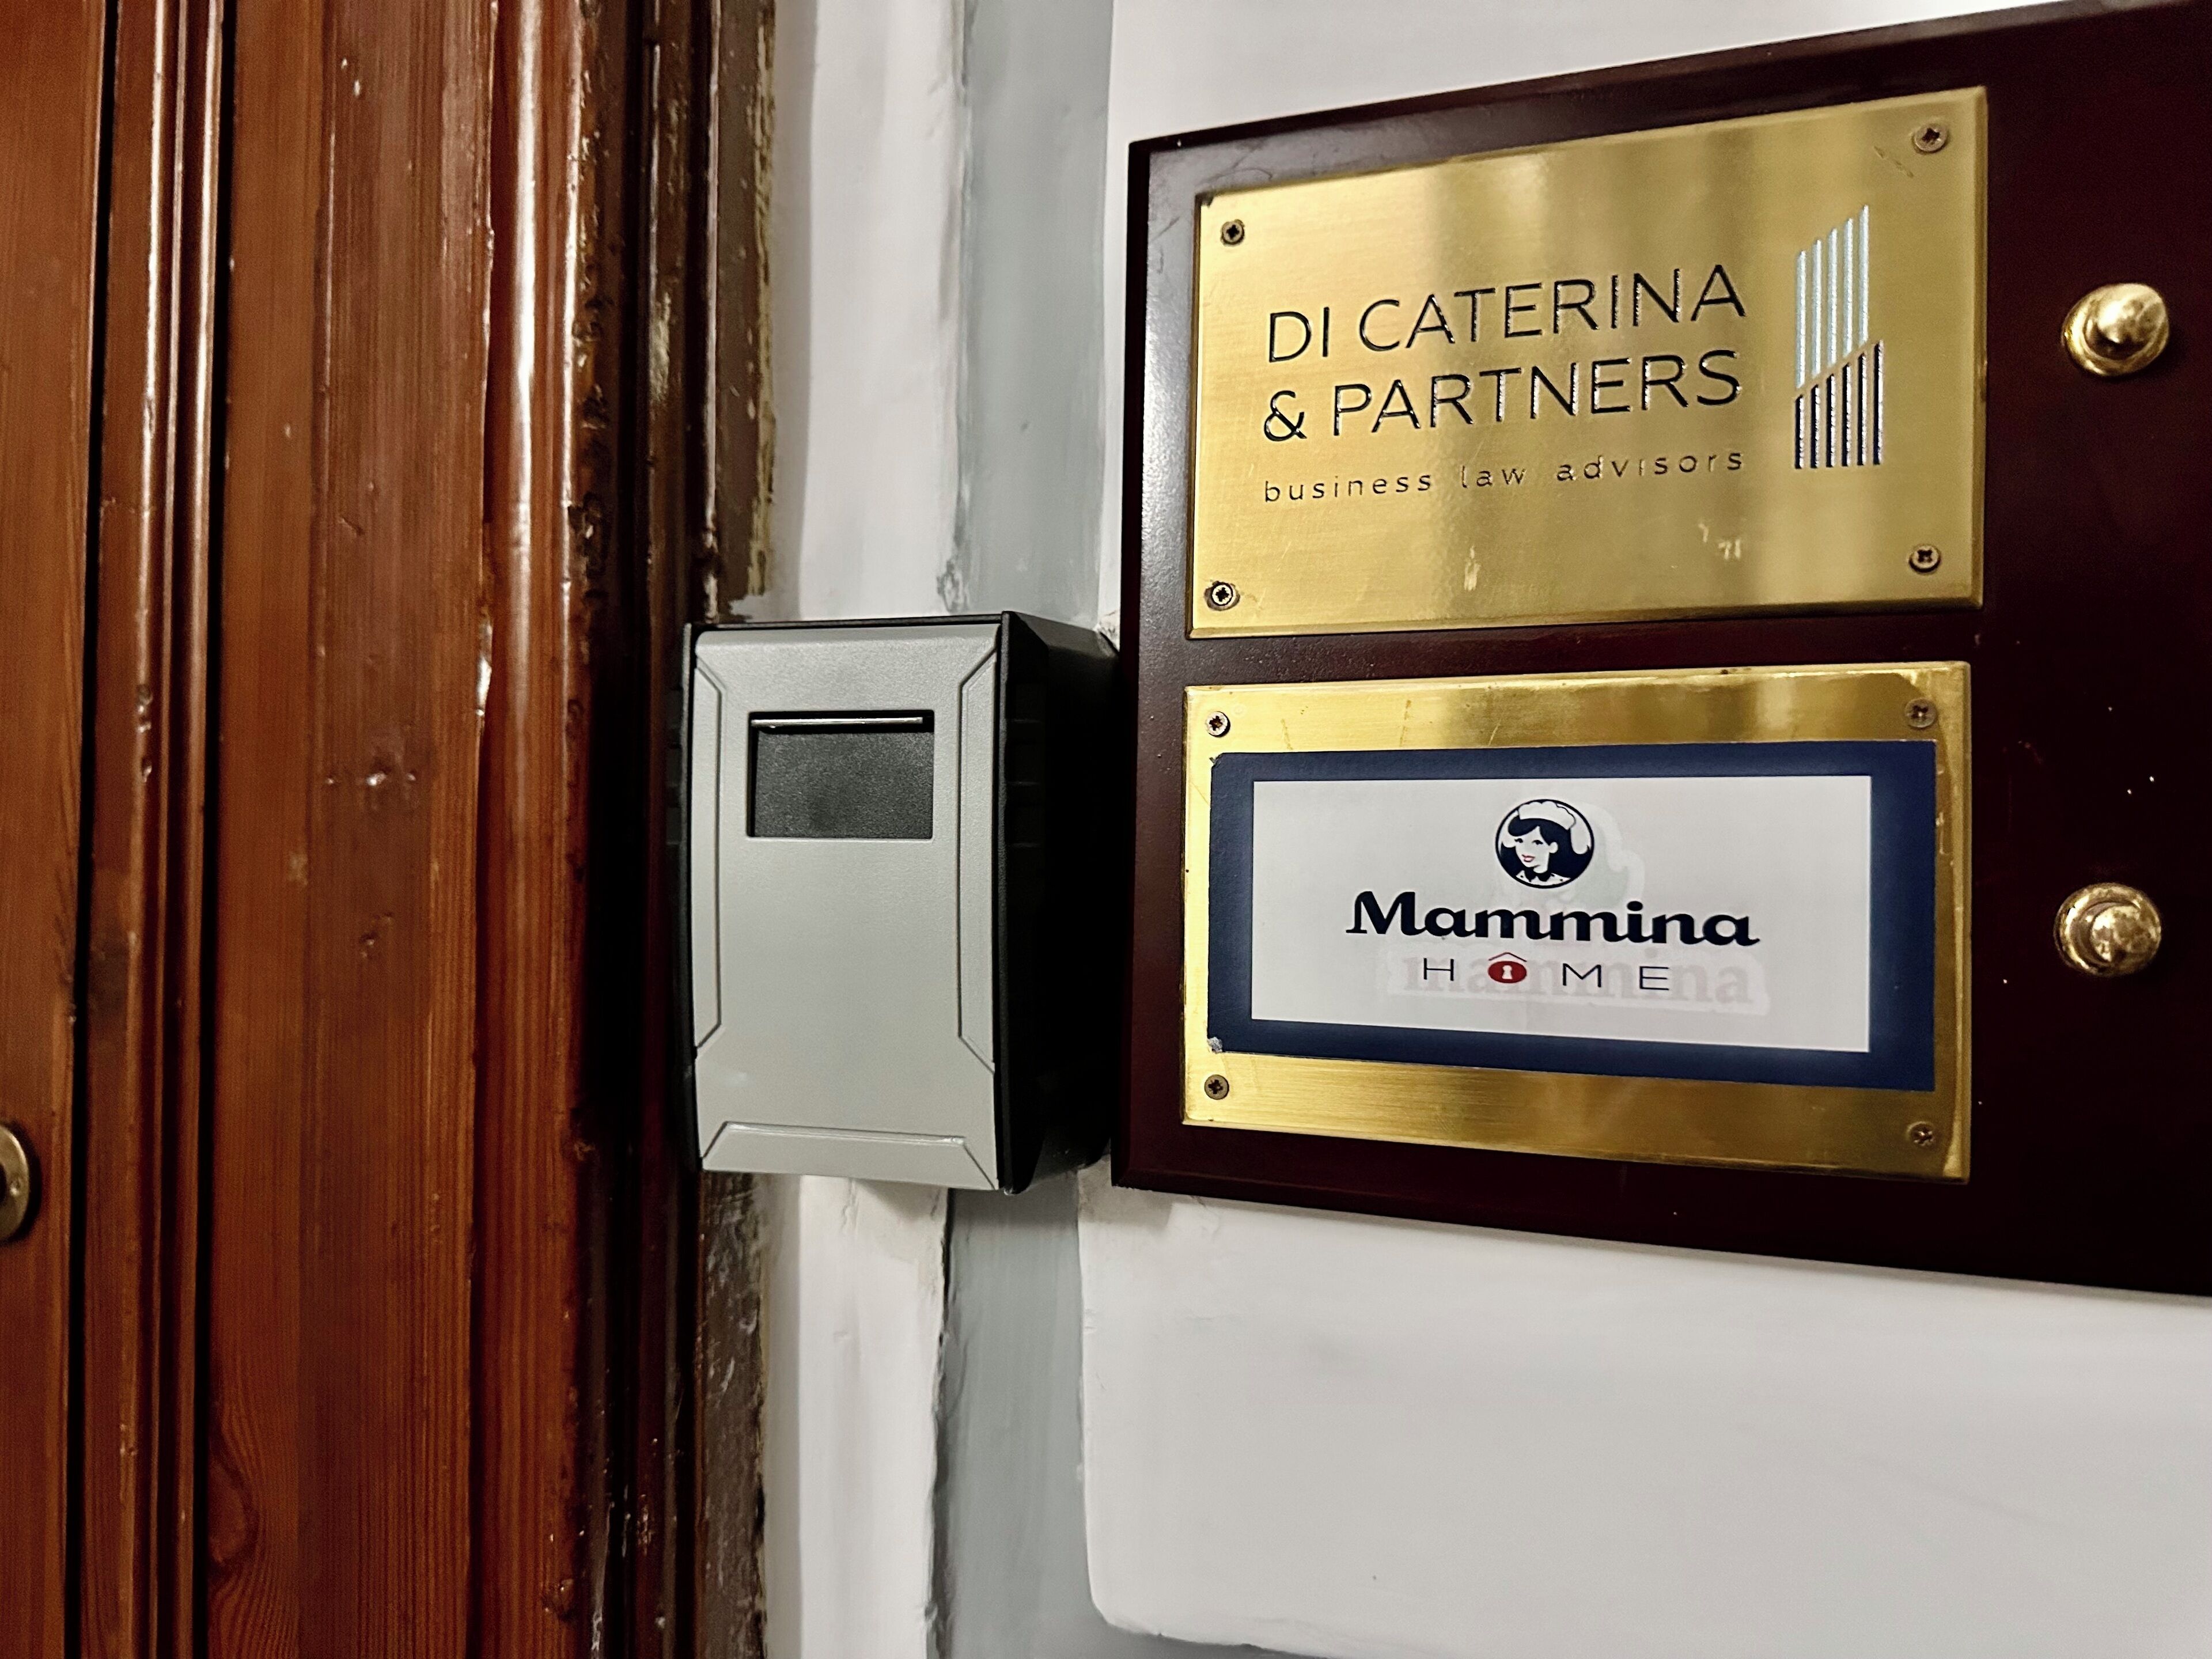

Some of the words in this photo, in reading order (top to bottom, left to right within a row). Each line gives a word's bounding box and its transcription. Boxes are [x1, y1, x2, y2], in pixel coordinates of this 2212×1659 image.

[1268, 306, 1330, 363] DI
[1358, 264, 1747, 351] CATERINA
[1263, 389, 1308, 442] &
[1332, 349, 1744, 437] PARTNERS
[1264, 474, 1432, 503] business
[1460, 464, 1527, 488] law
[1556, 451, 1743, 483] advisors
[1345, 890, 1760, 947] Mammina
